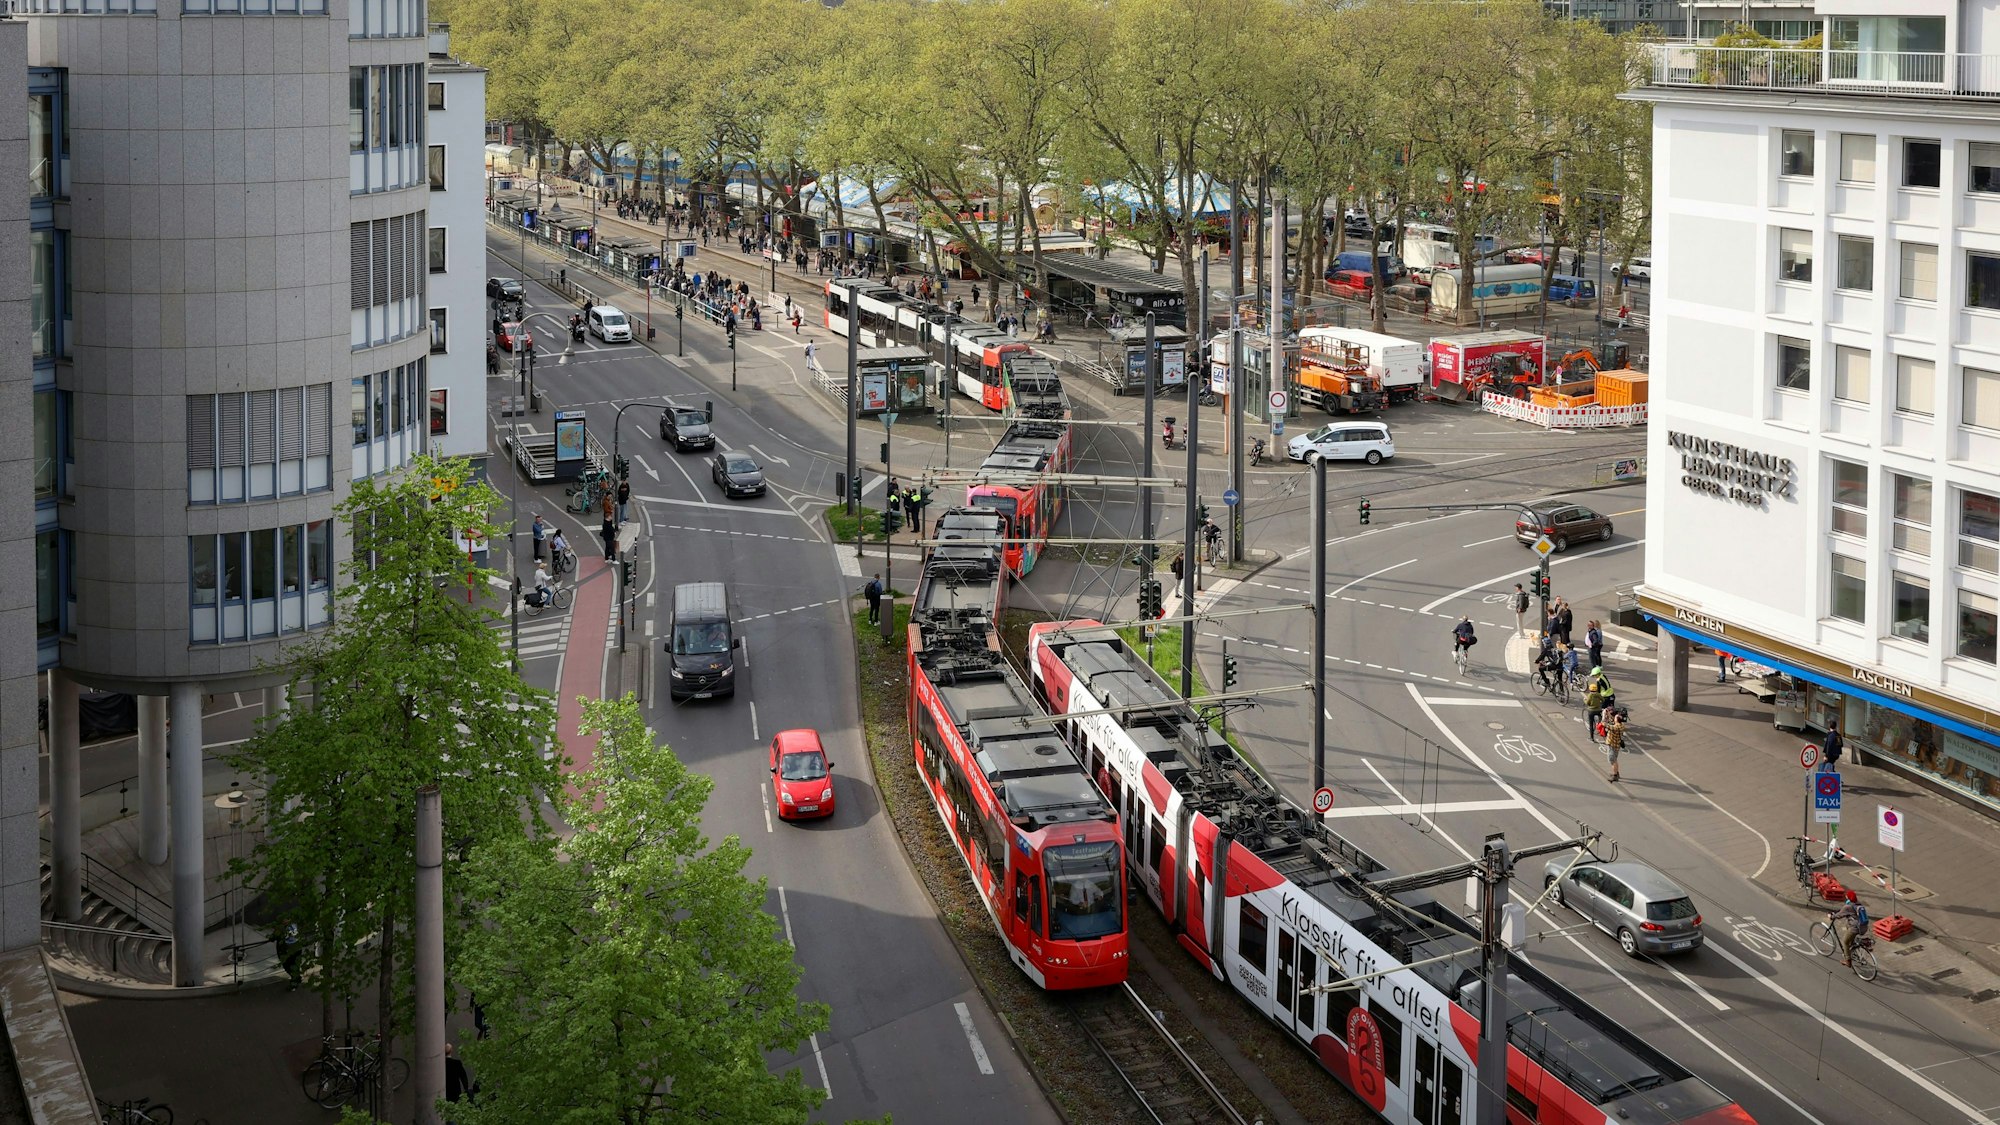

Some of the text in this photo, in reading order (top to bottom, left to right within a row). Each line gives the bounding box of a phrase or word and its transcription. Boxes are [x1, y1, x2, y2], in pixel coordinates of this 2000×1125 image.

[1667, 430, 1791, 476] KUNSTHAUS
[1681, 454, 1791, 498] LEMPERTZ
[1681, 475, 1725, 496] GEGR.
[1674, 607, 1725, 634] TASCHEN
[1852, 666, 1913, 698] TASCHEN
[1804, 750, 1815, 762] 30
[1317, 795, 1329, 806] 30
[1281, 892, 1441, 1035] Klassik für alle!
[1350, 1013, 1361, 1041] JAHRE
